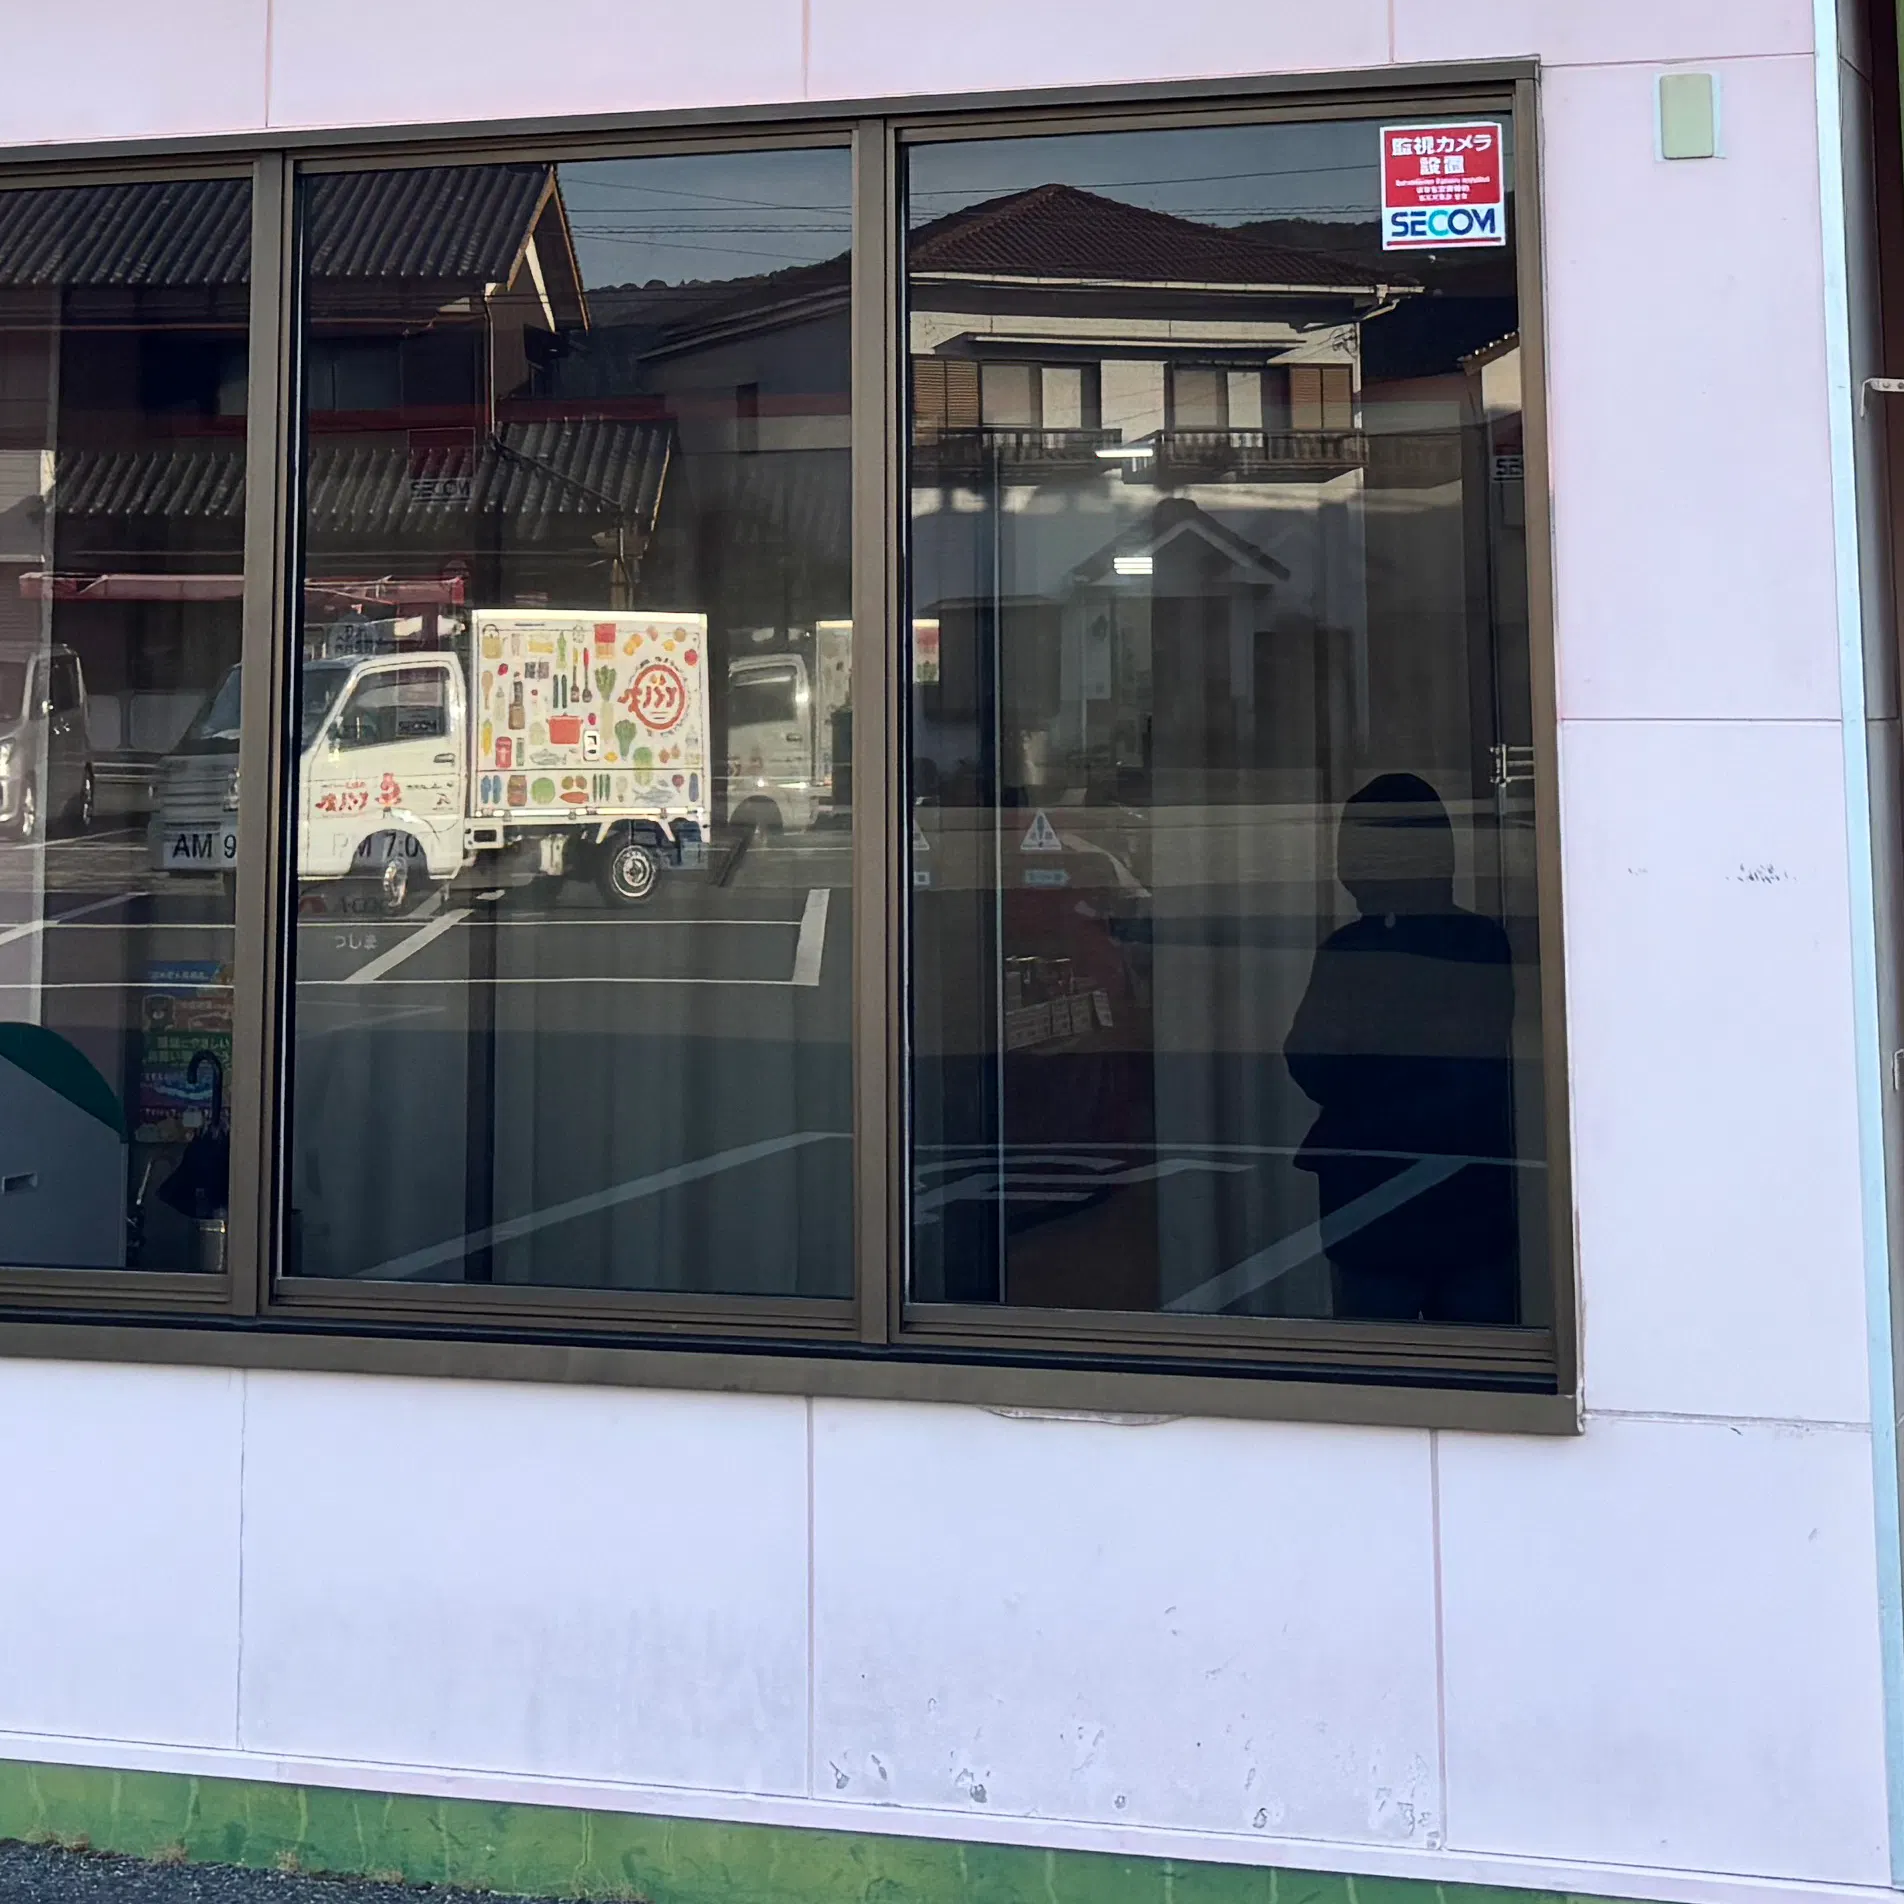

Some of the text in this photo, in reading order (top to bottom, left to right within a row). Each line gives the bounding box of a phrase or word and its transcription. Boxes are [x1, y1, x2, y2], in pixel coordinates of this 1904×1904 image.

[1391, 134, 1493, 156] 監視カメラ
[1419, 155, 1465, 176] 設置
[1391, 207, 1496, 238] SECOM
[172, 833, 213, 859] AM
